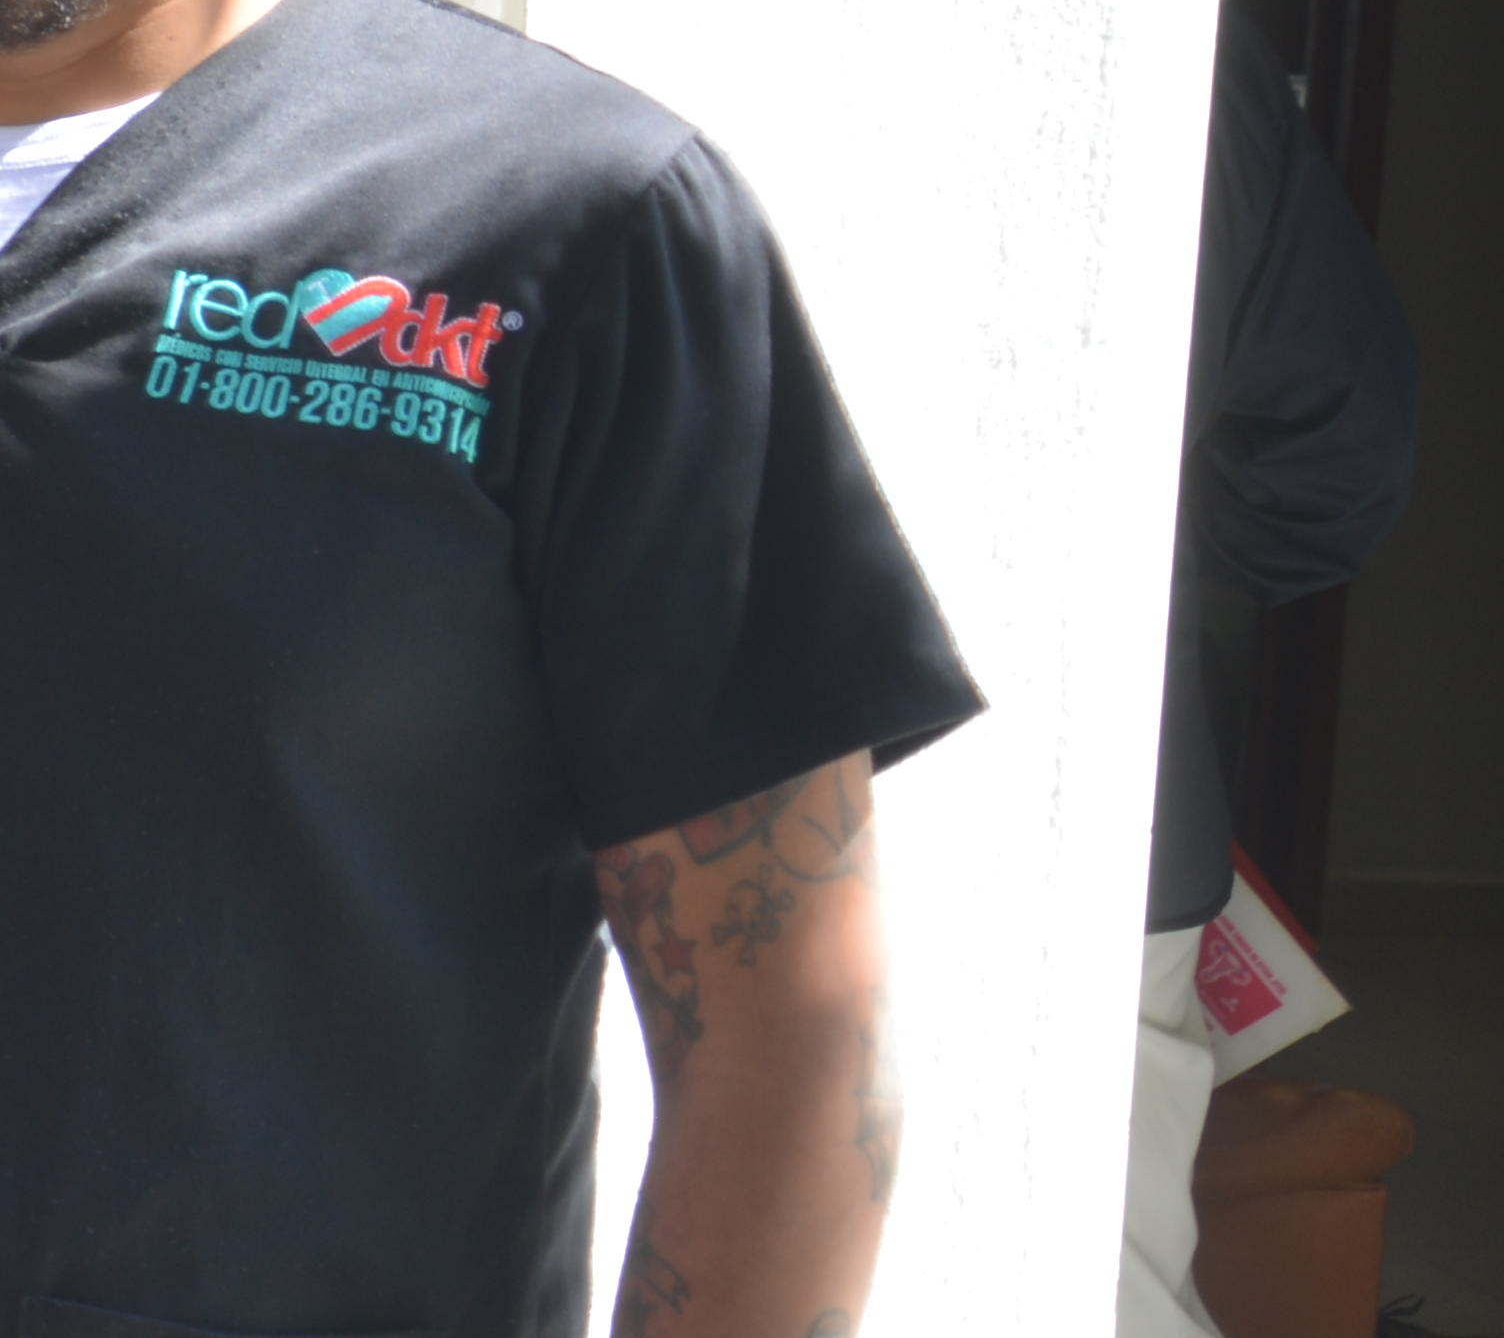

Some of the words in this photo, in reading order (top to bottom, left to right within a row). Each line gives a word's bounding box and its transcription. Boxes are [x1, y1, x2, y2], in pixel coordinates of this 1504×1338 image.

[163, 268, 304, 350] red
[145, 355, 482, 463] 01-800-286-9314
[245, 354, 303, 375] SERVICIO
[305, 360, 368, 384] INTEGRAL
